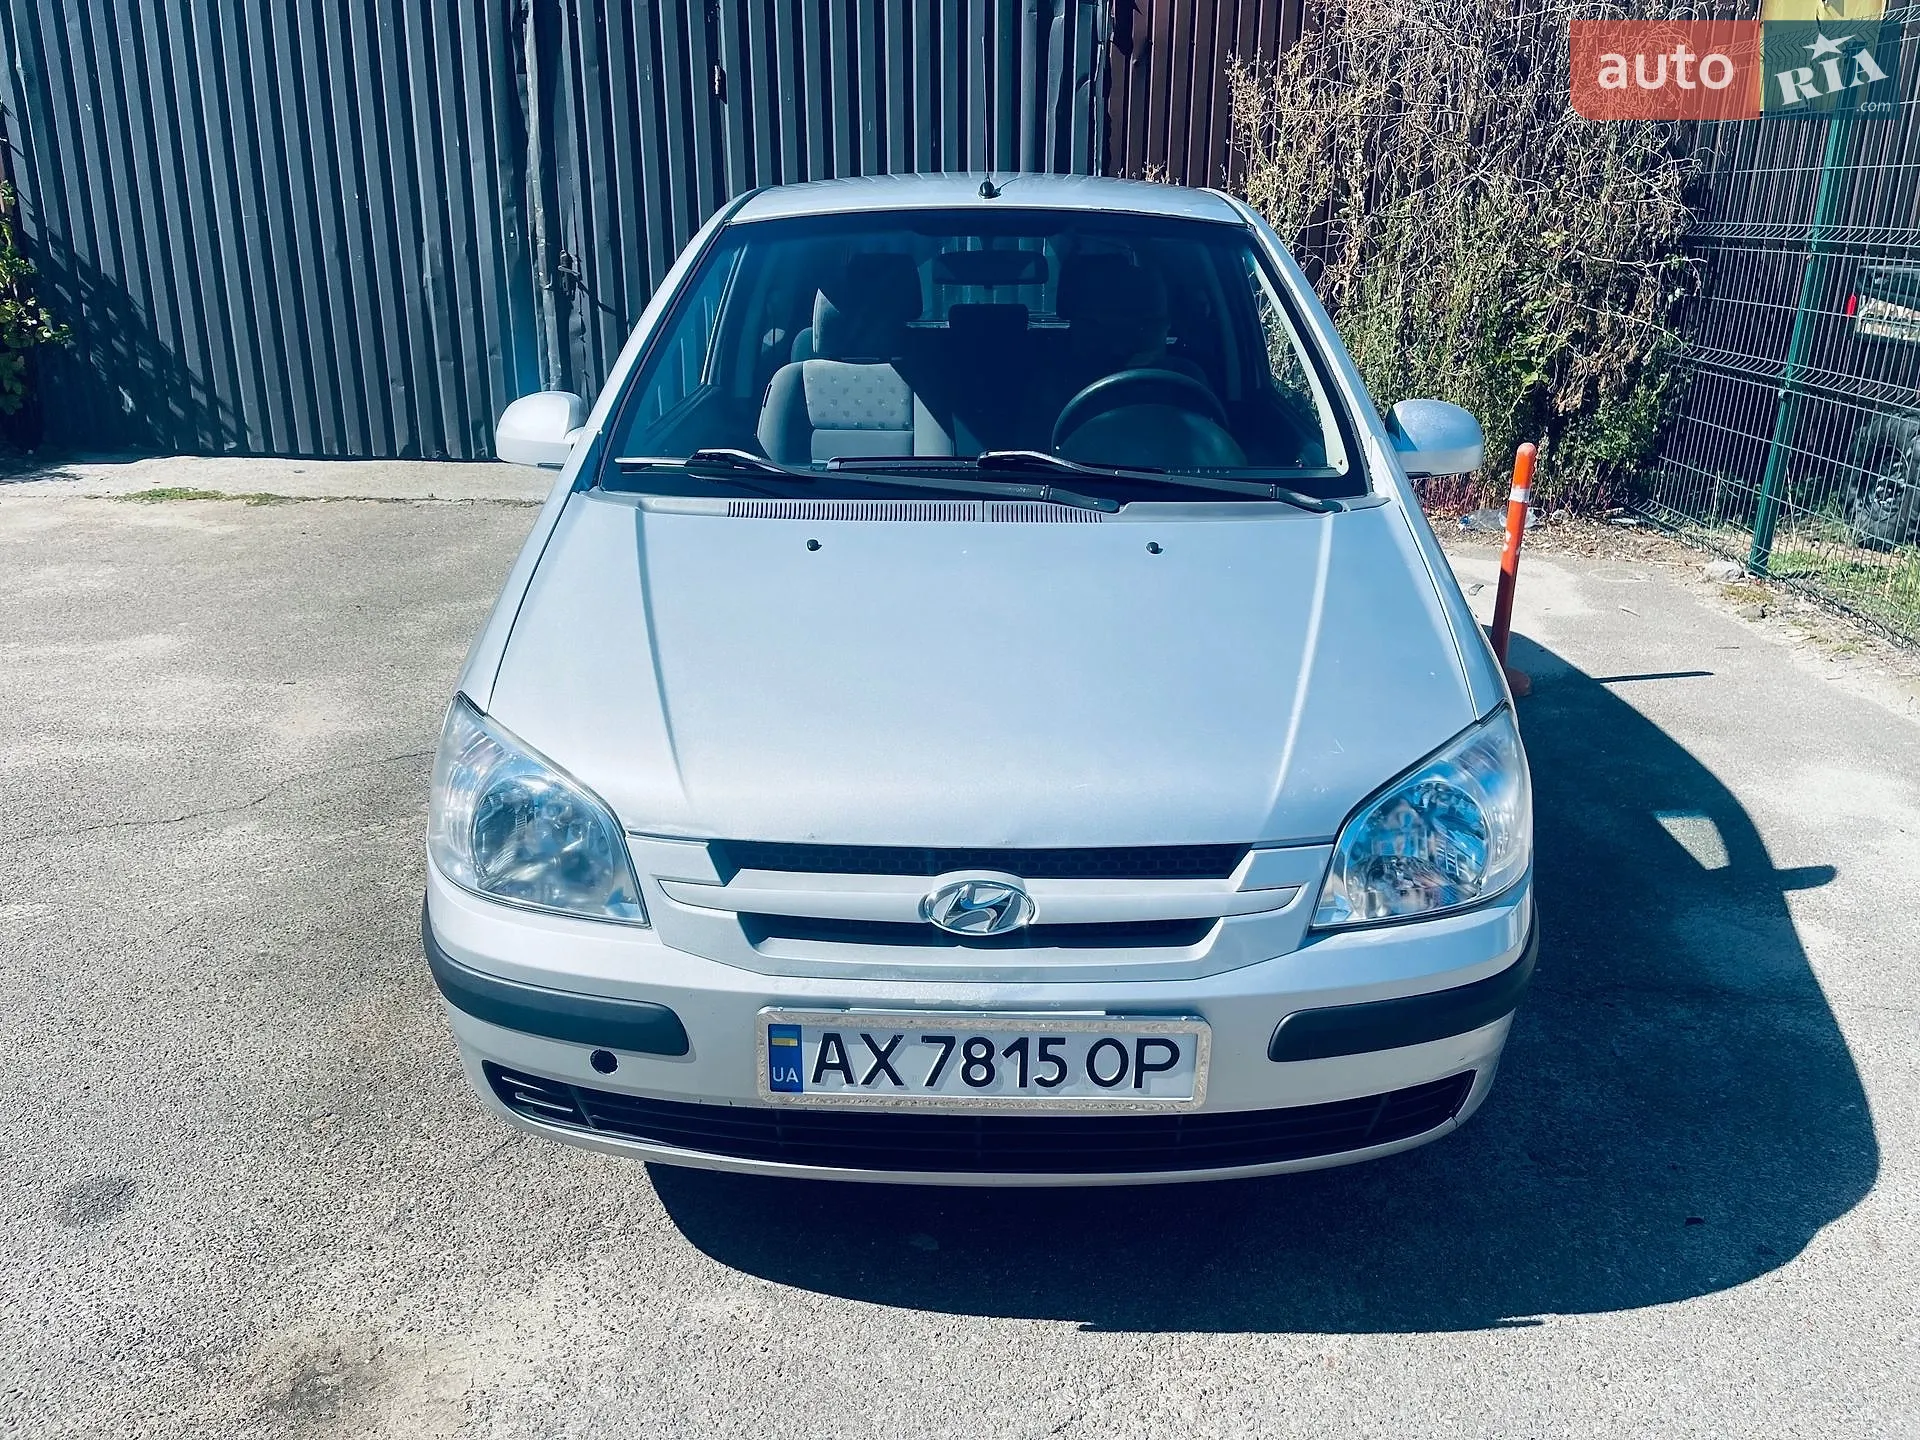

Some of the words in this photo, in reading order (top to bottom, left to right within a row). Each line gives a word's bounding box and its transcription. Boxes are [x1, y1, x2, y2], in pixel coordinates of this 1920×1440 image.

[773, 1066, 799, 1084] UA
[811, 1032, 904, 1087] AX
[921, 1035, 1068, 1088] 7815
[1085, 1037, 1180, 1089] OP
